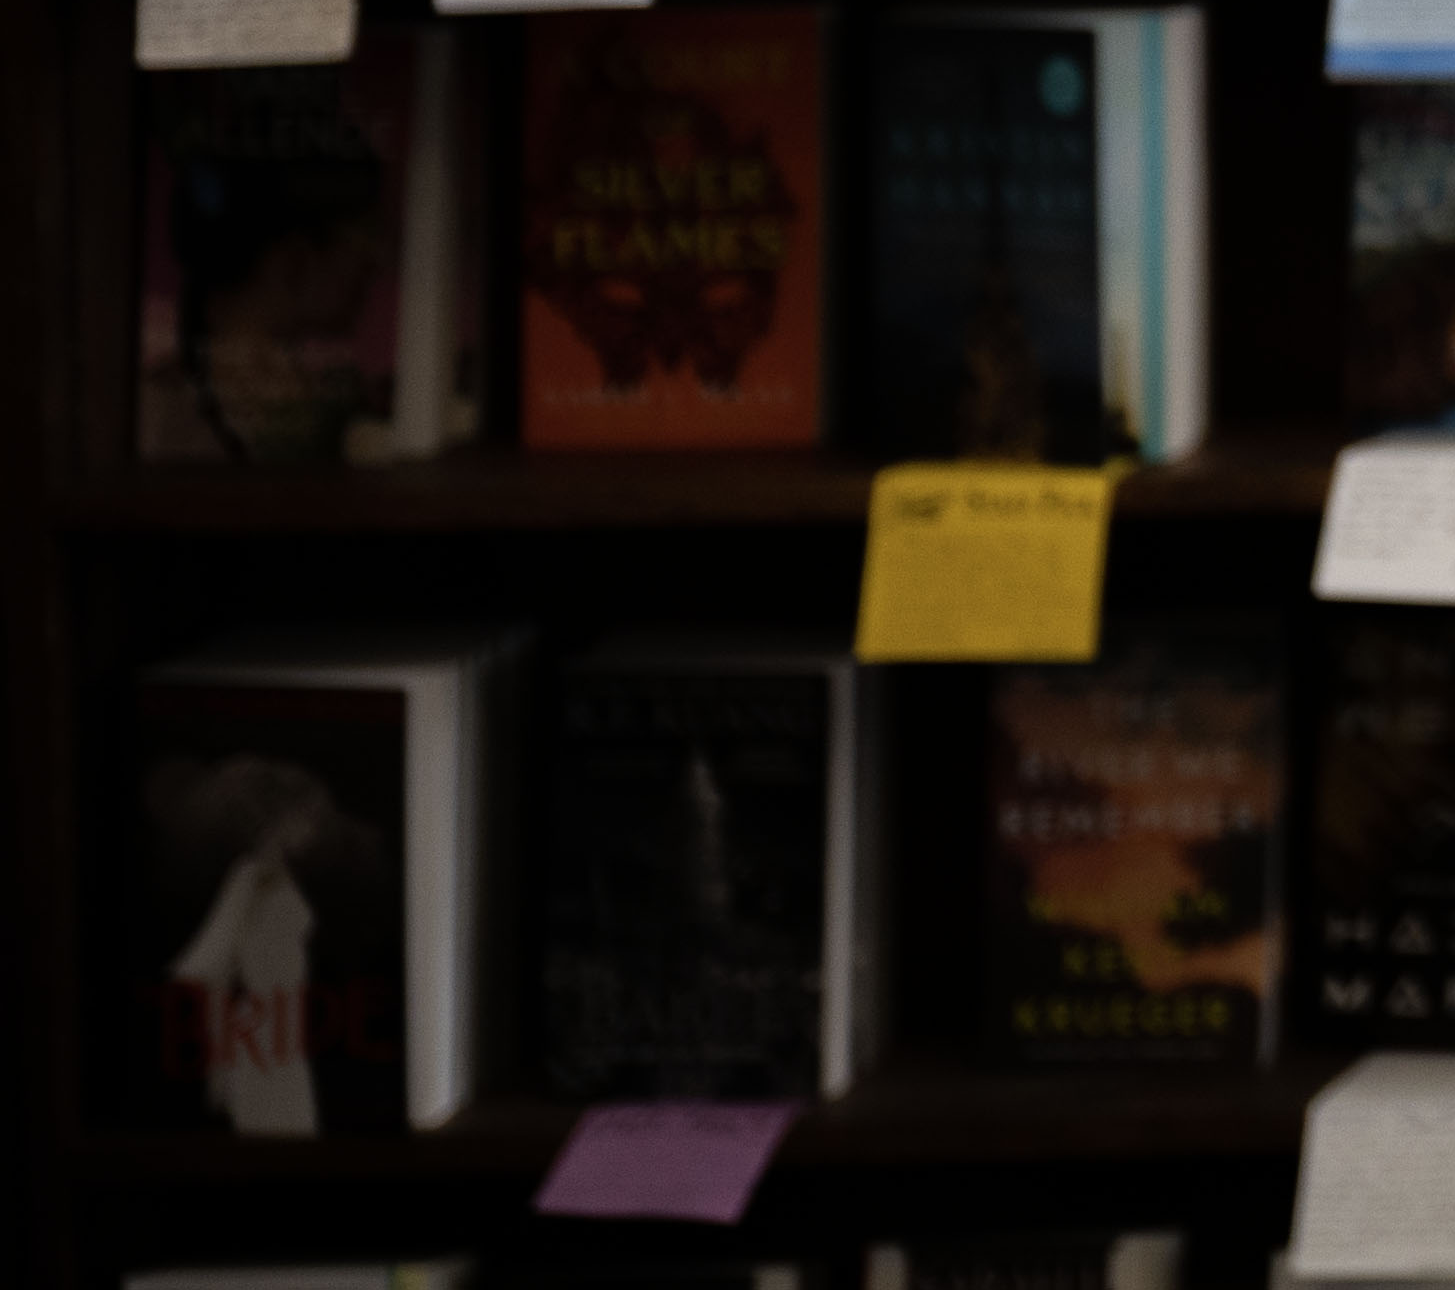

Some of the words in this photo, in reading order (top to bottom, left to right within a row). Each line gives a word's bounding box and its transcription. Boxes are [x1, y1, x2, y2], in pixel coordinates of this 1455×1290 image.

[572, 157, 767, 209] SILVER
[551, 221, 785, 270] FLAMES
[158, 972, 399, 1082] BRIDE
